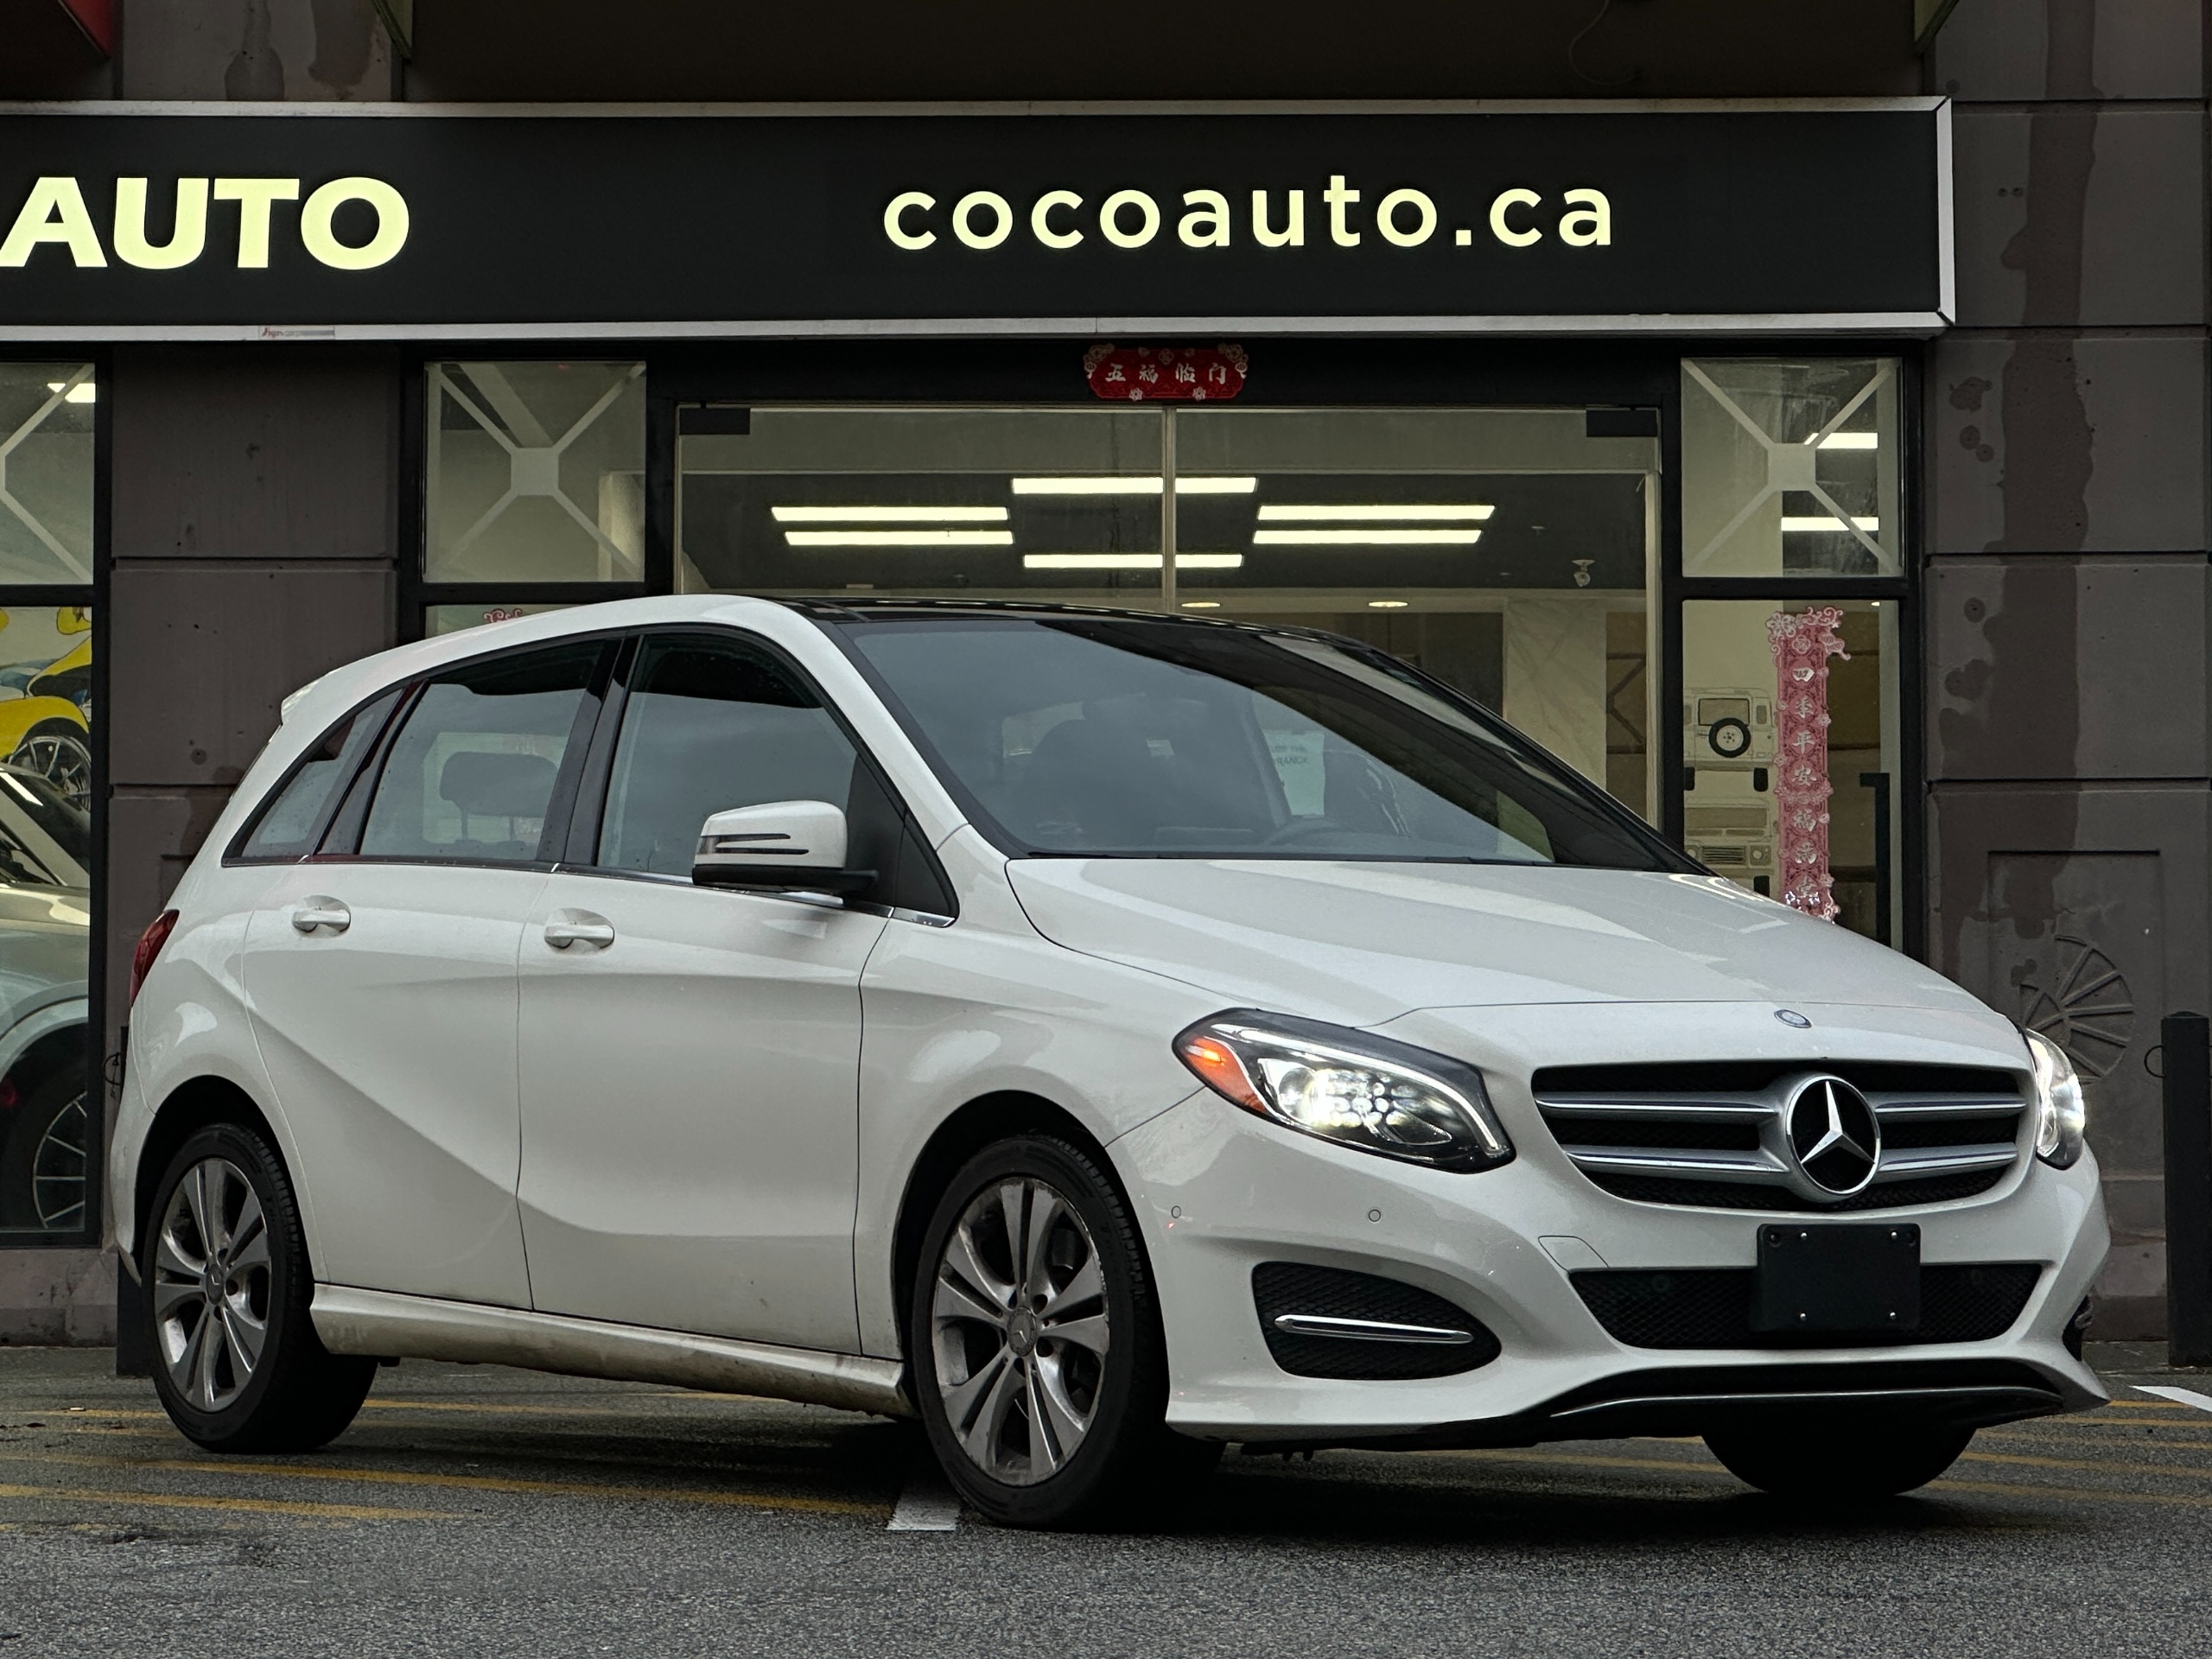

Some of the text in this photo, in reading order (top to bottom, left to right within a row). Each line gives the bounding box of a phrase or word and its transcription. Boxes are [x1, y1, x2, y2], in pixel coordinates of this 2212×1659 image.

[0, 176, 410, 270] AUTO
[883, 175, 1611, 251] cocoauto.ca
[1104, 362, 1227, 385] 五福临门
